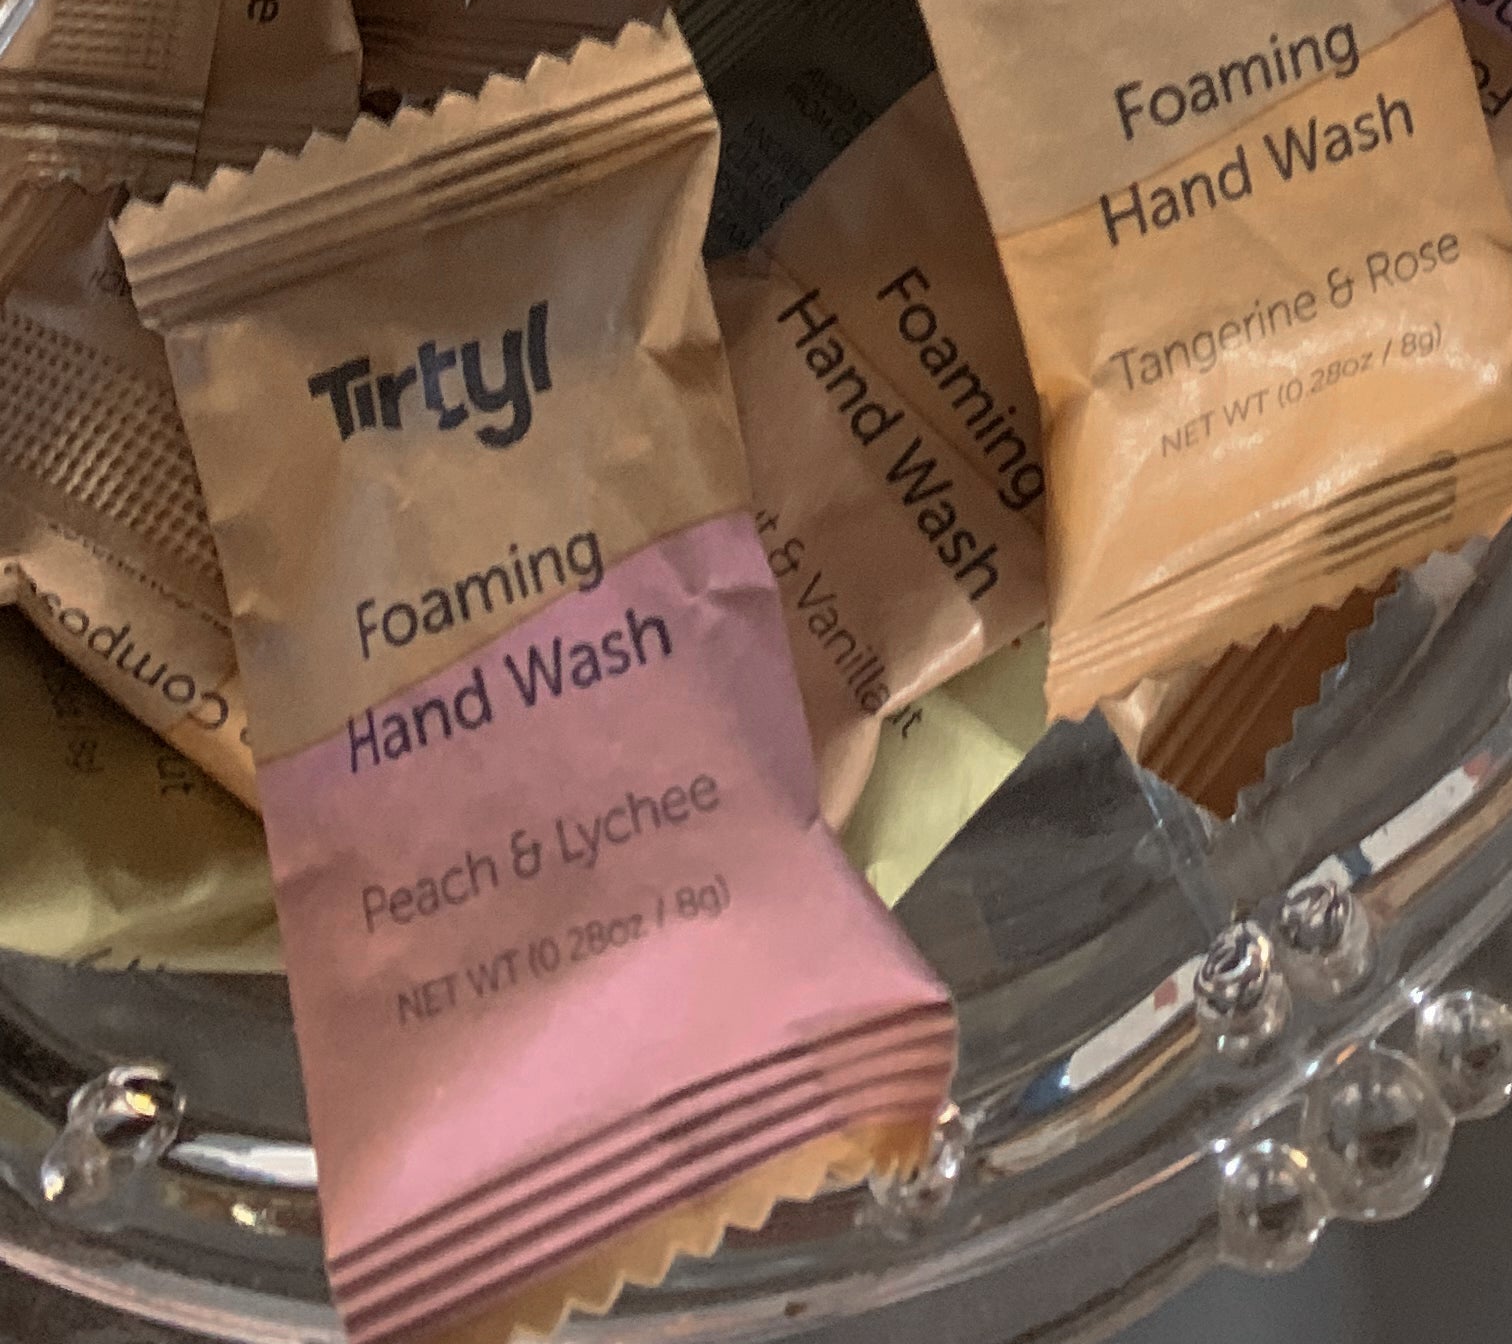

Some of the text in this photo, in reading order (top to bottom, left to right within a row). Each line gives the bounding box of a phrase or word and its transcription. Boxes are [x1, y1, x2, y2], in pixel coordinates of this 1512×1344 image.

[1114, 20, 1361, 141] Foaming
[1099, 91, 1416, 247] Hand Wash
[307, 300, 551, 449] Tirtyl
[877, 265, 1047, 513] Foaming
[1109, 232, 1462, 391] Tangerine & Rose
[1161, 410, 1217, 458] NET
[1223, 388, 1270, 427] WT
[1400, 321, 1443, 358] 8g)
[776, 286, 905, 447] Hand
[885, 437, 1000, 603] Wash
[355, 527, 605, 661] Foaming
[767, 536, 892, 714] & Vanilla
[345, 607, 673, 775] Hand Wash
[361, 772, 721, 934] Peach & Lychee
[397, 971, 459, 1026] NET
[466, 946, 521, 999] WT
[673, 873, 732, 921] 8g)
